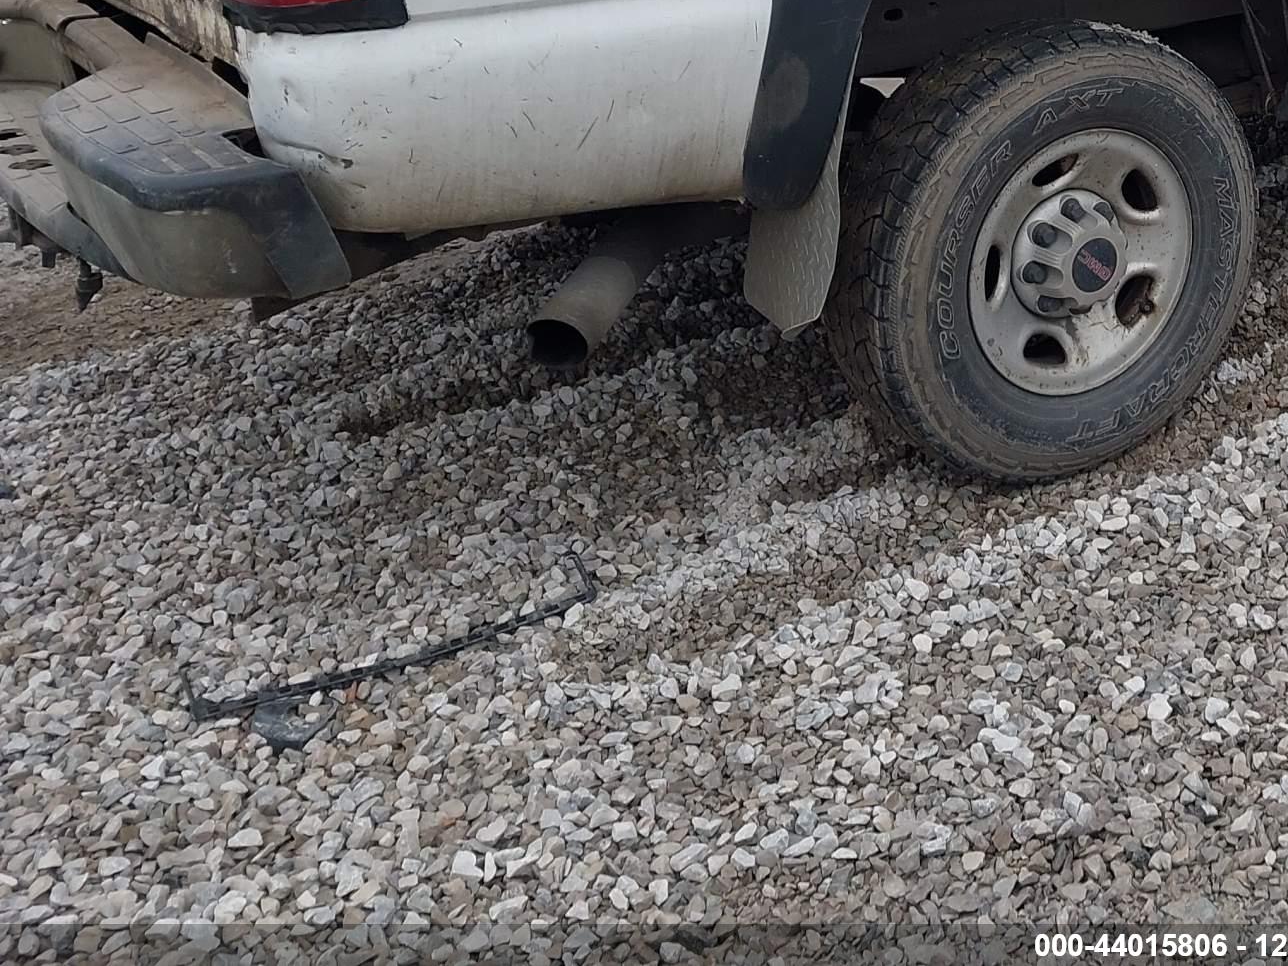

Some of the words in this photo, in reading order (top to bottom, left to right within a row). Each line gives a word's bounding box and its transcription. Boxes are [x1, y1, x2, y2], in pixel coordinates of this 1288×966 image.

[940, 140, 1012, 361] COURSER
[1034, 87, 1125, 134] AXT
[1077, 250, 1112, 281] GMC
